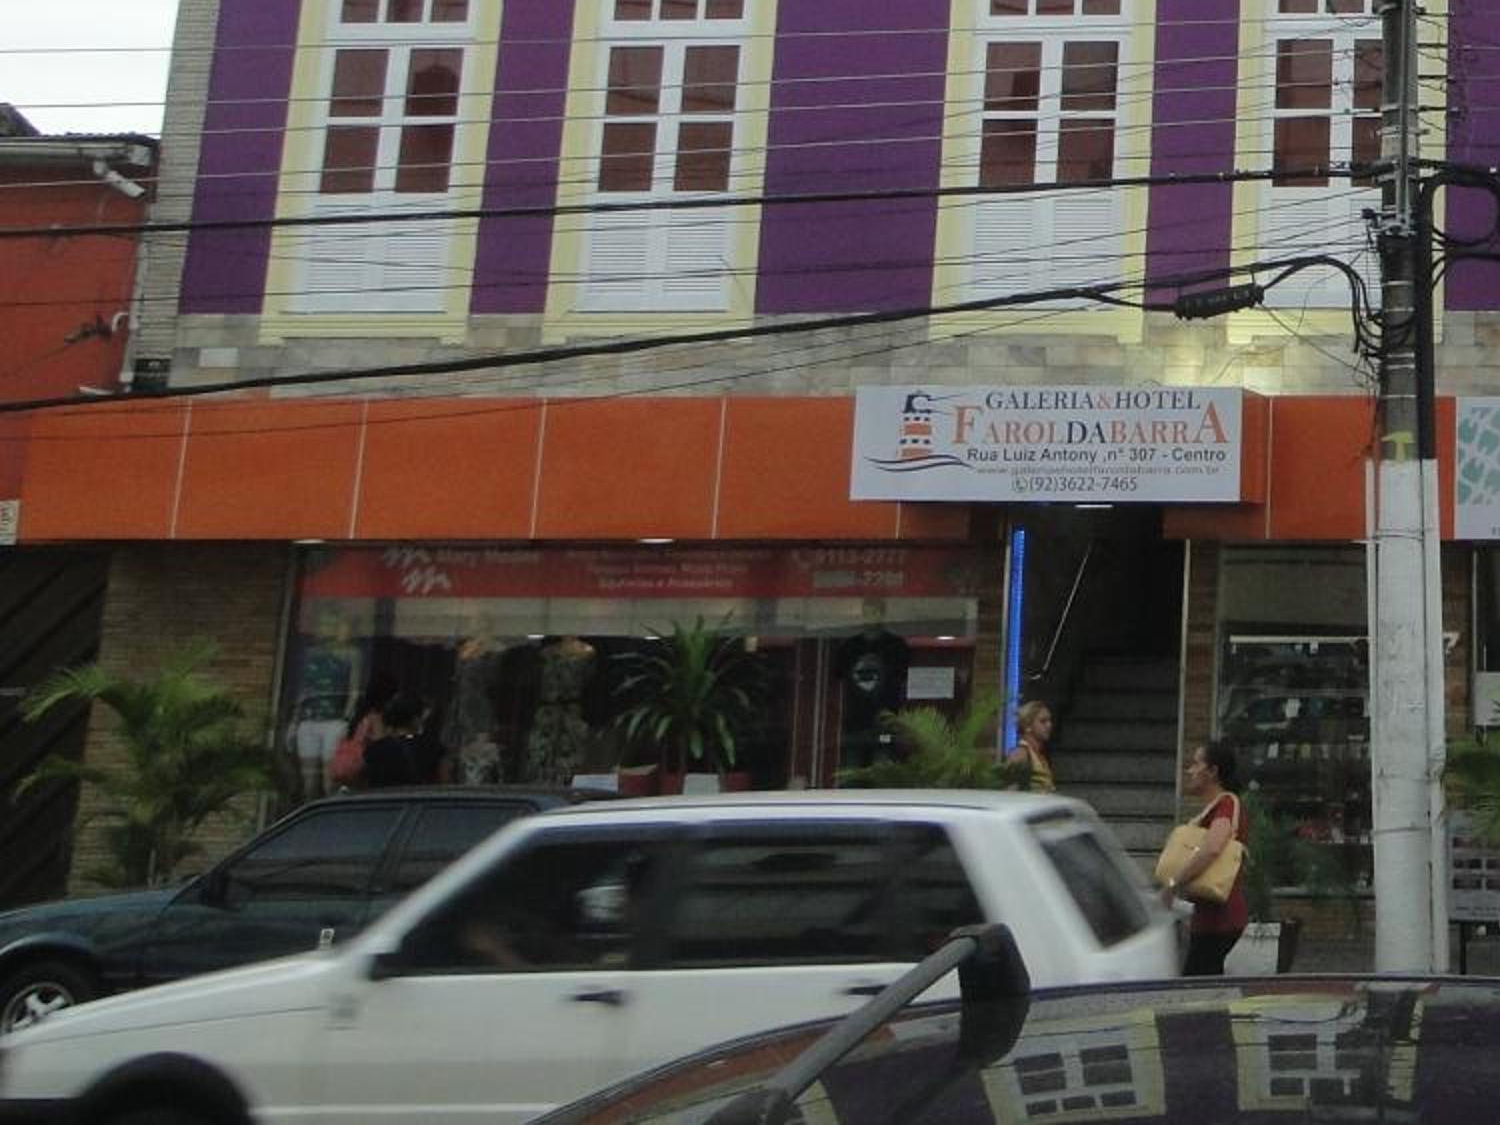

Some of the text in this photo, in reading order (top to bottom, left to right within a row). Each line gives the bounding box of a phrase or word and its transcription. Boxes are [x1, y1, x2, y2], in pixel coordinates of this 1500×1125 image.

[967, 448, 998, 462] Rua
[1003, 447, 1036, 462] Luiz
[1040, 448, 1095, 464] Antony
[1129, 448, 1156, 462] 307
[1172, 447, 1226, 462] Centro
[1029, 476, 1137, 492] (92)3622-7465
